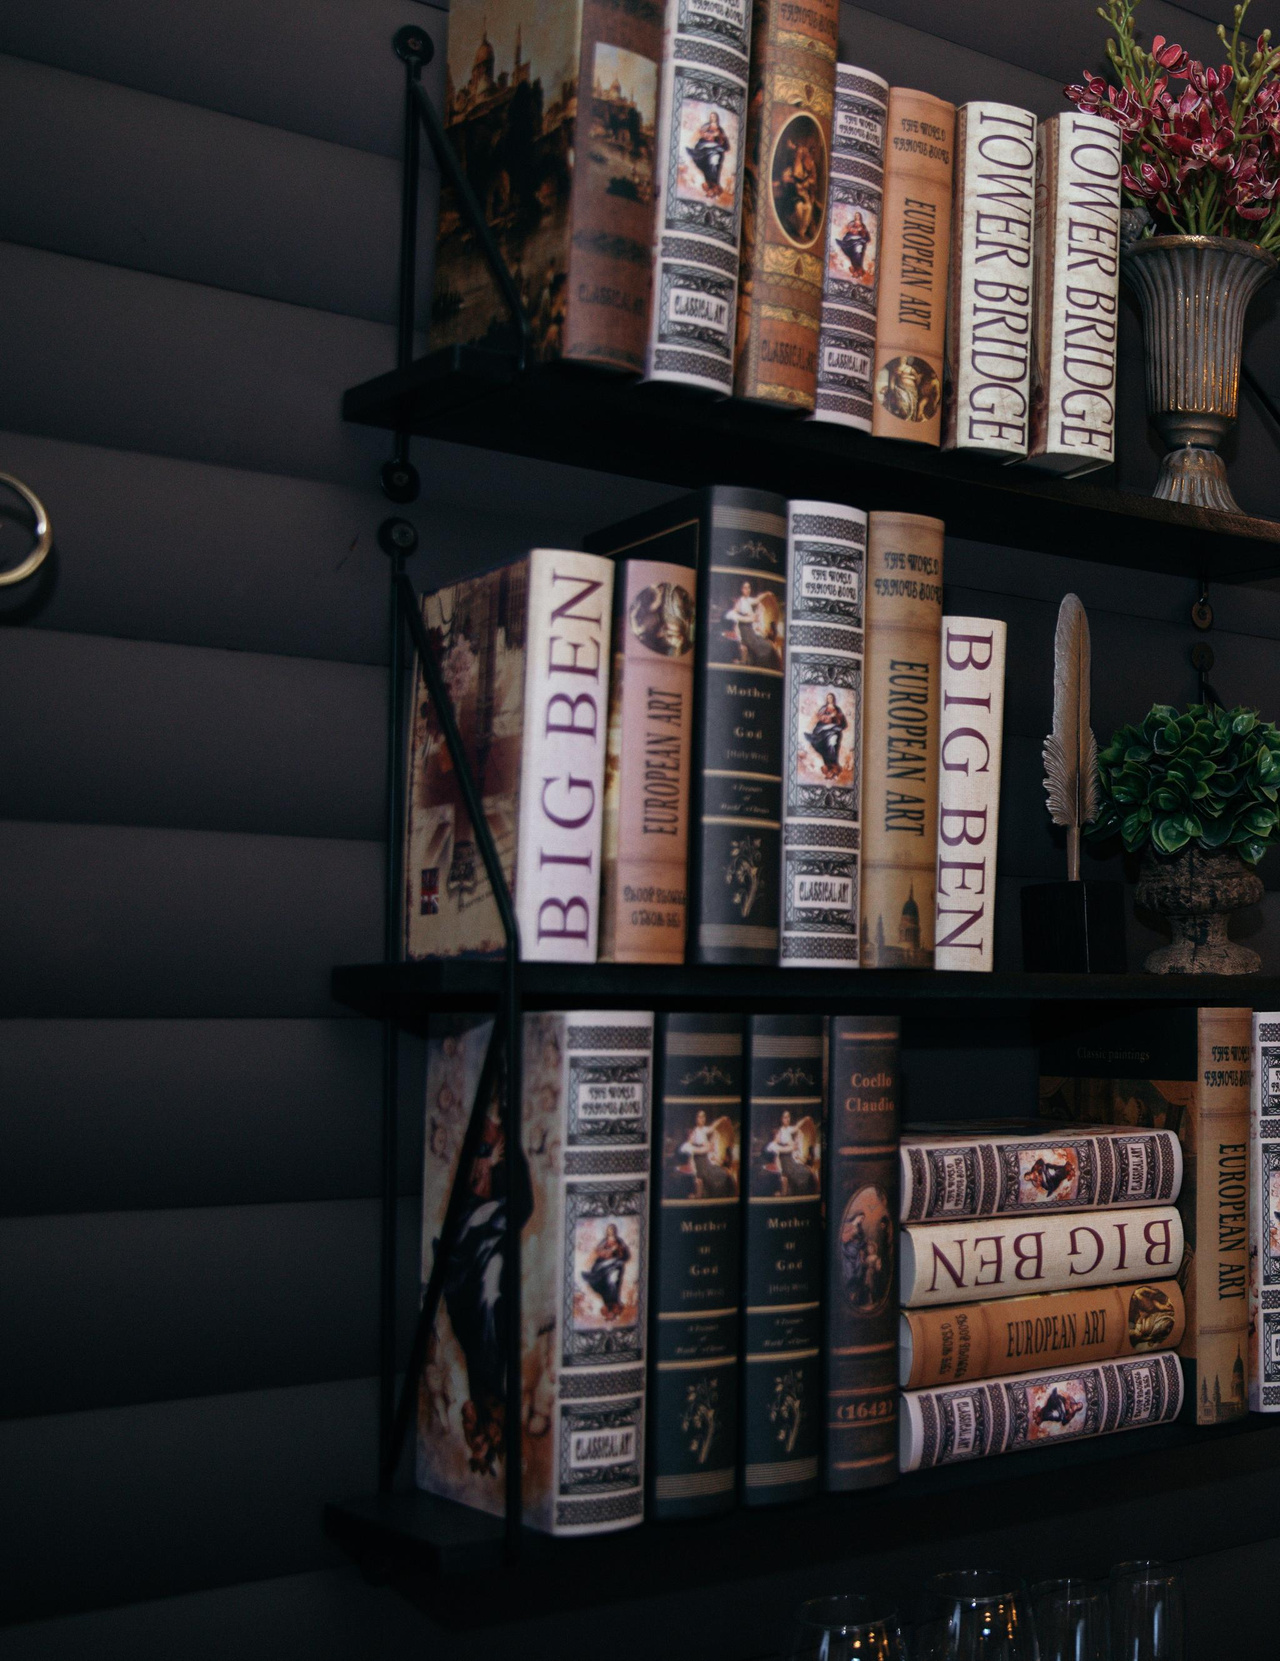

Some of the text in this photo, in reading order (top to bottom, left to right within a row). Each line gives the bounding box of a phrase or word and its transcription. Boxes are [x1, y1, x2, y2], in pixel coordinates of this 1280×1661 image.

[898, 198, 937, 331] EUROPEAN ART
[968, 110, 1036, 449] TOWER BRIDGE
[1059, 119, 1123, 456] TOWER BRIDGE
[674, 295, 726, 325] CLASSICAL ART
[828, 352, 859, 370] CLASSICAL
[726, 684, 772, 700] Mother
[734, 726, 762, 740] God
[884, 658, 930, 837] EUROPEAN ART
[536, 568, 605, 948] BIG BEN
[642, 688, 683, 837] EUROPEAN ART
[935, 626, 994, 956] BIG BEN
[799, 881, 849, 905] CLASSICAL ART
[1076, 1046, 1151, 1064] Classic paintings
[851, 1071, 892, 1088] Coello
[845, 1097, 895, 1113] Claudio
[1130, 1146, 1144, 1191] CLASSICAL ART
[680, 1221, 727, 1233] Mother
[767, 1217, 810, 1230] Mother
[1218, 1143, 1247, 1301] EUROPEAN ART
[775, 1258, 803, 1272] God
[925, 1218, 1174, 1292] BIG BEN
[689, 1264, 718, 1277] God
[1006, 1308, 1108, 1358] EUROPEAN ART
[836, 1400, 893, 1422] (1642)
[956, 1401, 972, 1449] CLASSICAL ART
[575, 1433, 633, 1462] CLASSICAL ART
